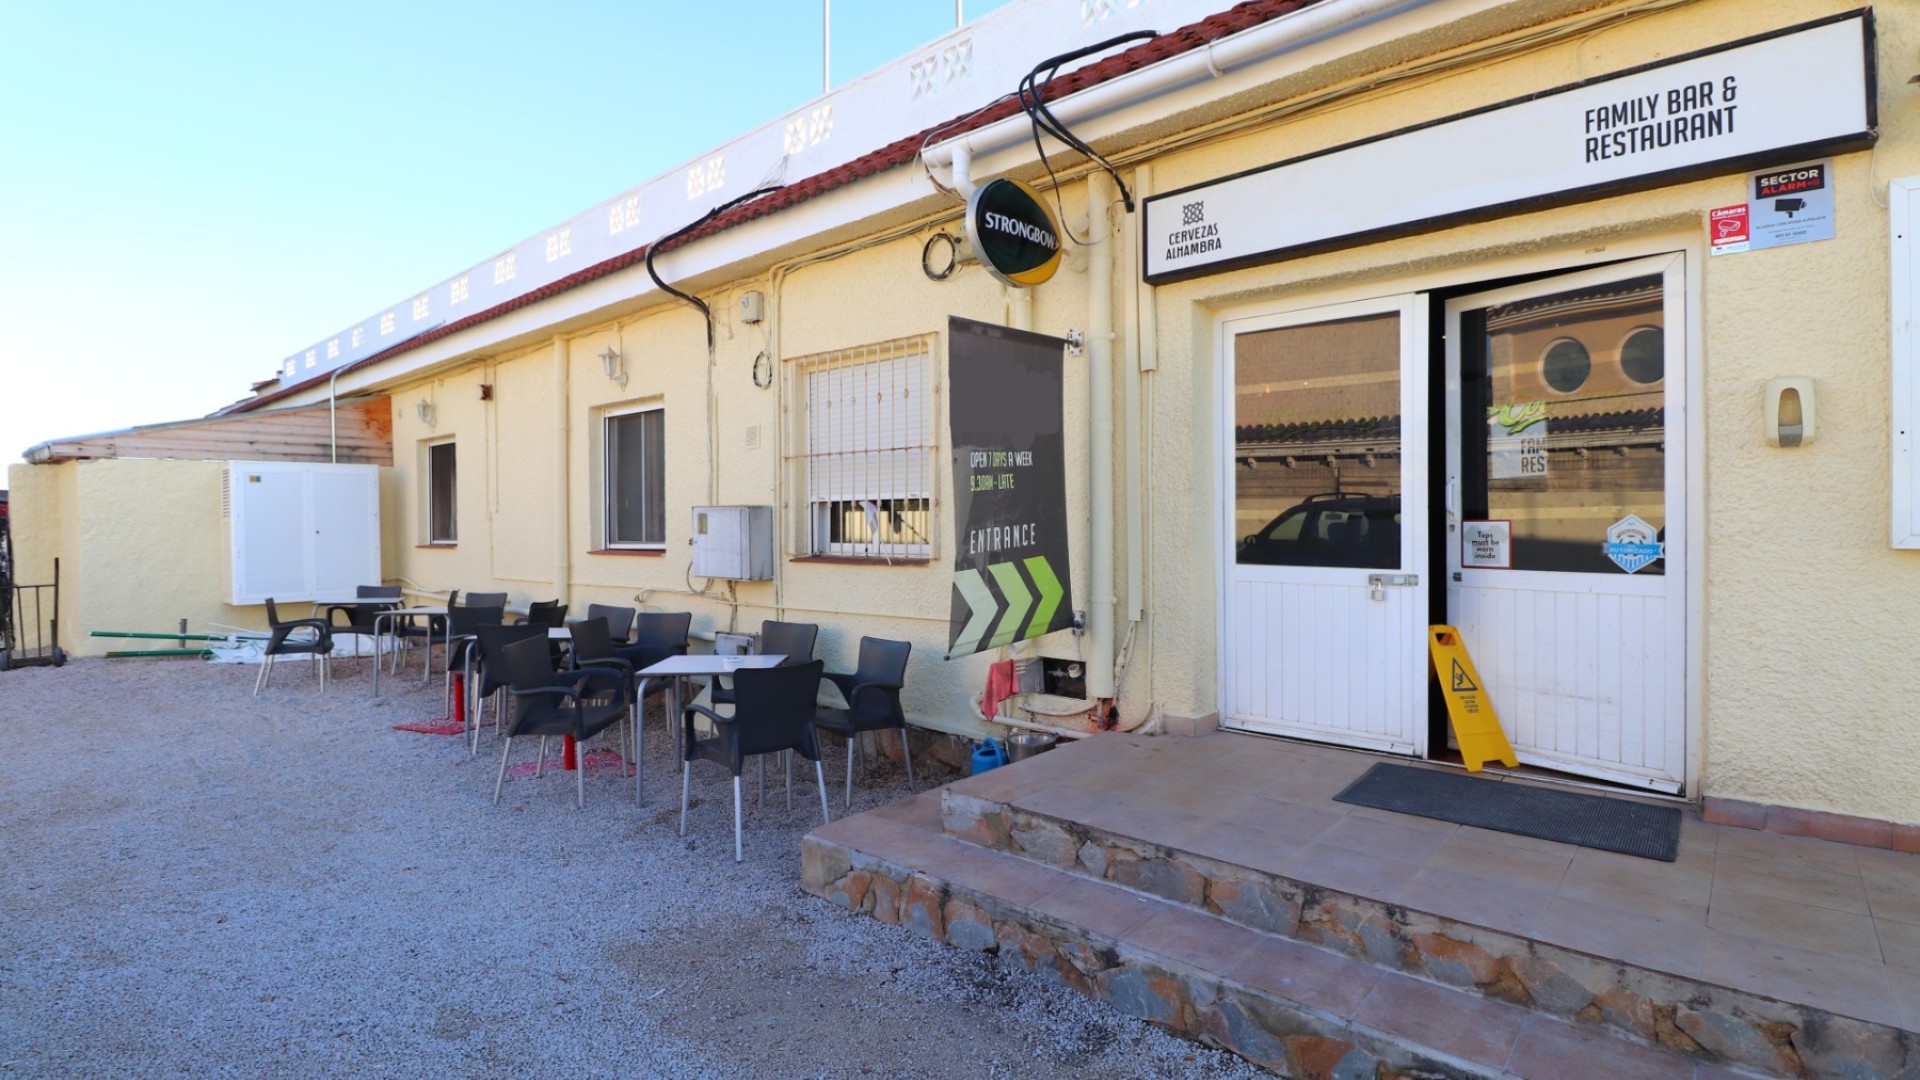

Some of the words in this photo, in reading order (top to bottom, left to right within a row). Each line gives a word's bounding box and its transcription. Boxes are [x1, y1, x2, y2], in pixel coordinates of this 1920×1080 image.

[1585, 93, 1659, 134] FAMILY
[1667, 81, 1713, 115] BAR
[1722, 76, 1738, 102] &
[1585, 105, 1737, 163] RESTAURANT
[1760, 169, 1819, 187] SECTOR
[1761, 181, 1806, 195] ALARM
[985, 211, 1056, 250] STRONGBOW
[1168, 222, 1218, 245] CERVEZAS
[1165, 237, 1222, 261] ALHAMBRA
[970, 451, 987, 468] OPEN
[992, 451, 1007, 467] DAYS
[1008, 451, 1014, 467] A
[1014, 451, 1033, 467] WEEK
[998, 474, 1015, 489] LATE
[970, 523, 1036, 554] ENTRANCE
[1477, 531, 1493, 540] Tops
